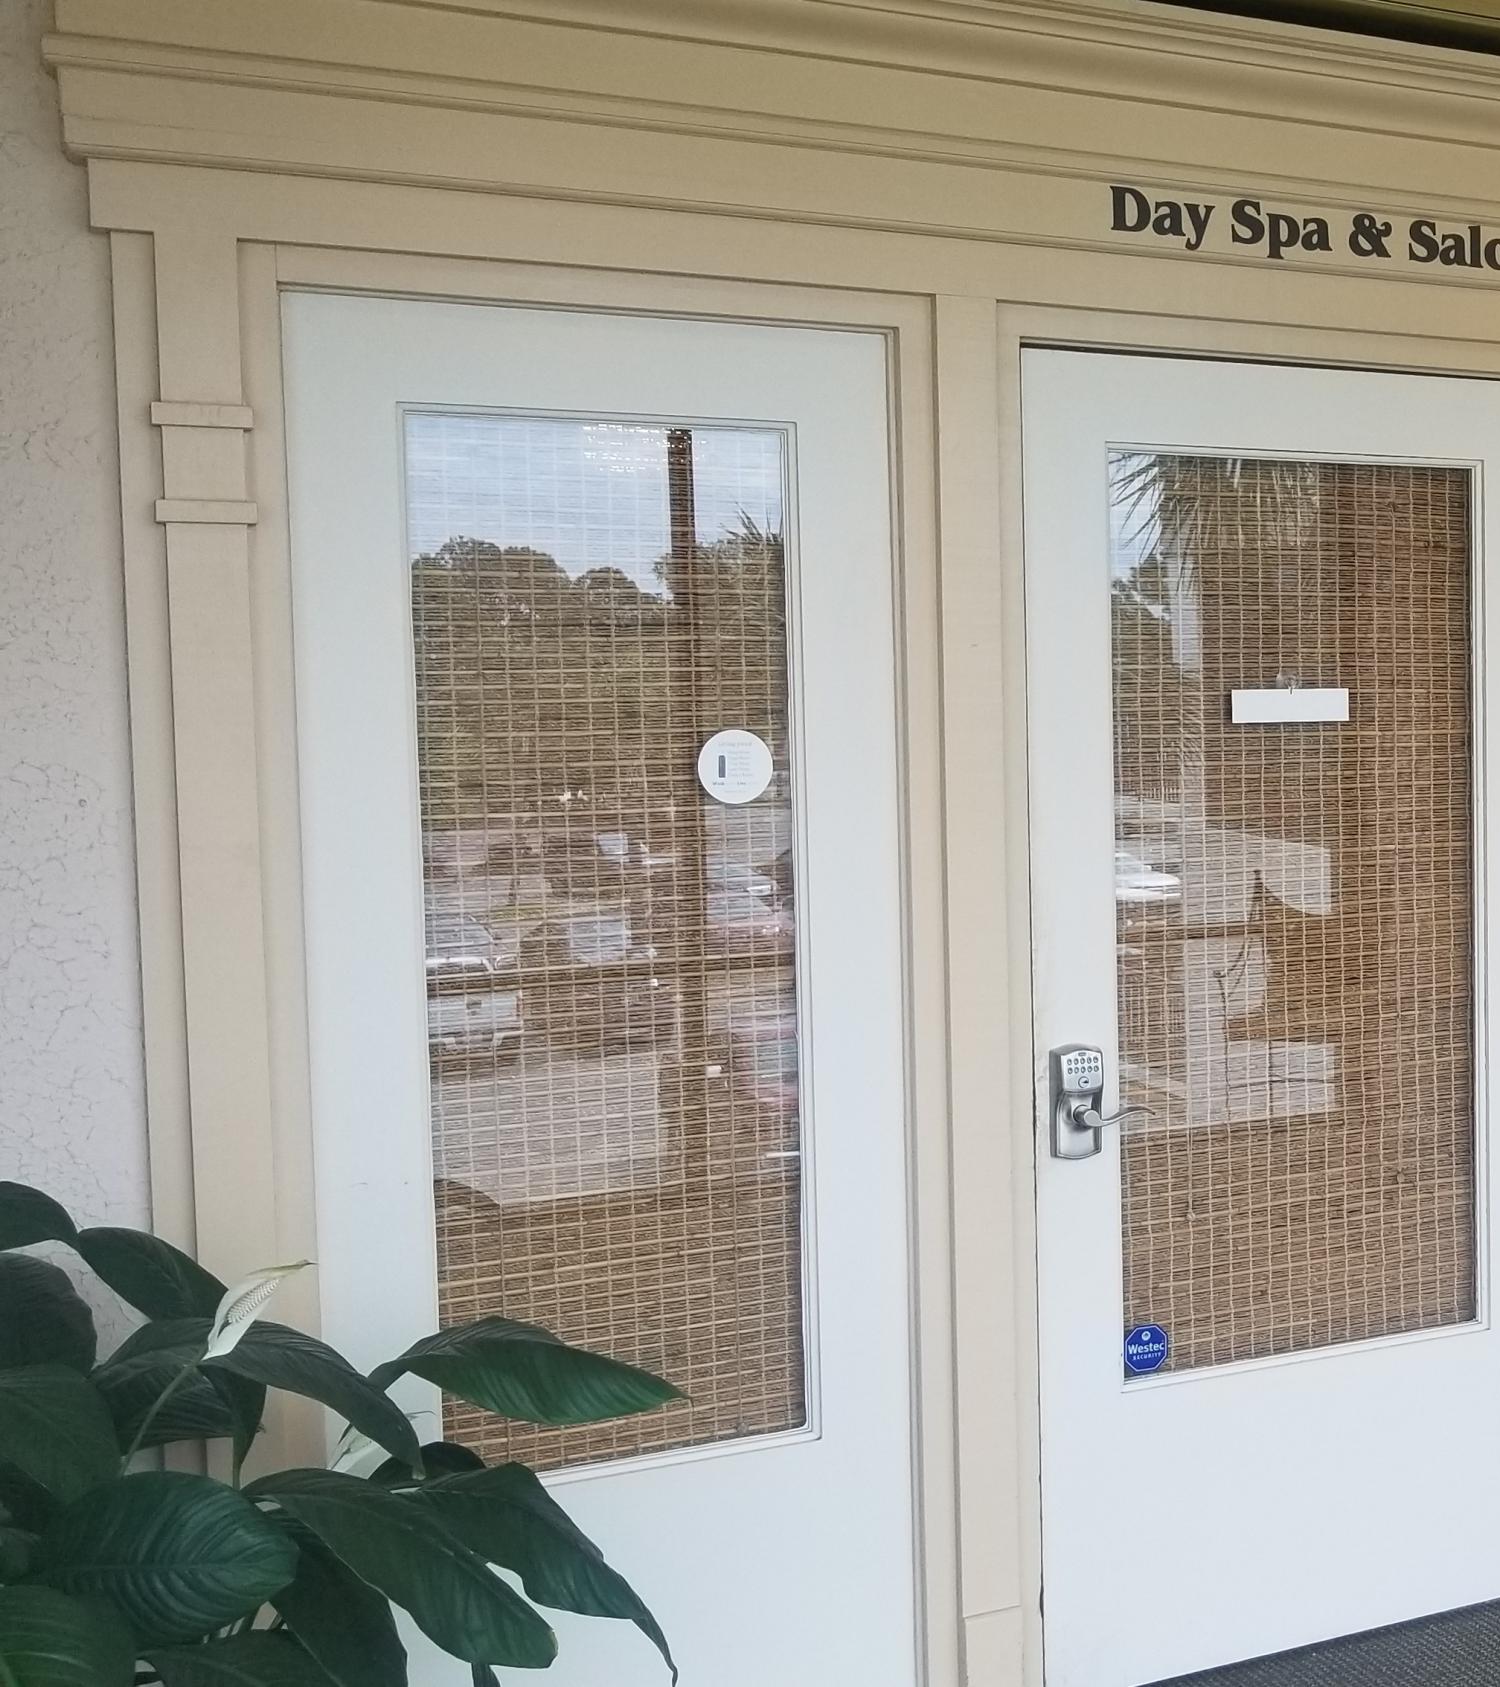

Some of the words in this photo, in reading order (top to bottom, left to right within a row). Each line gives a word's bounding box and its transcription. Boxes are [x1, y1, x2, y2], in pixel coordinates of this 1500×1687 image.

[1110, 185, 1215, 250] Day
[1230, 199, 1333, 259] Spa
[1348, 213, 1392, 258] &
[1127, 1342, 1164, 1355] Westec
